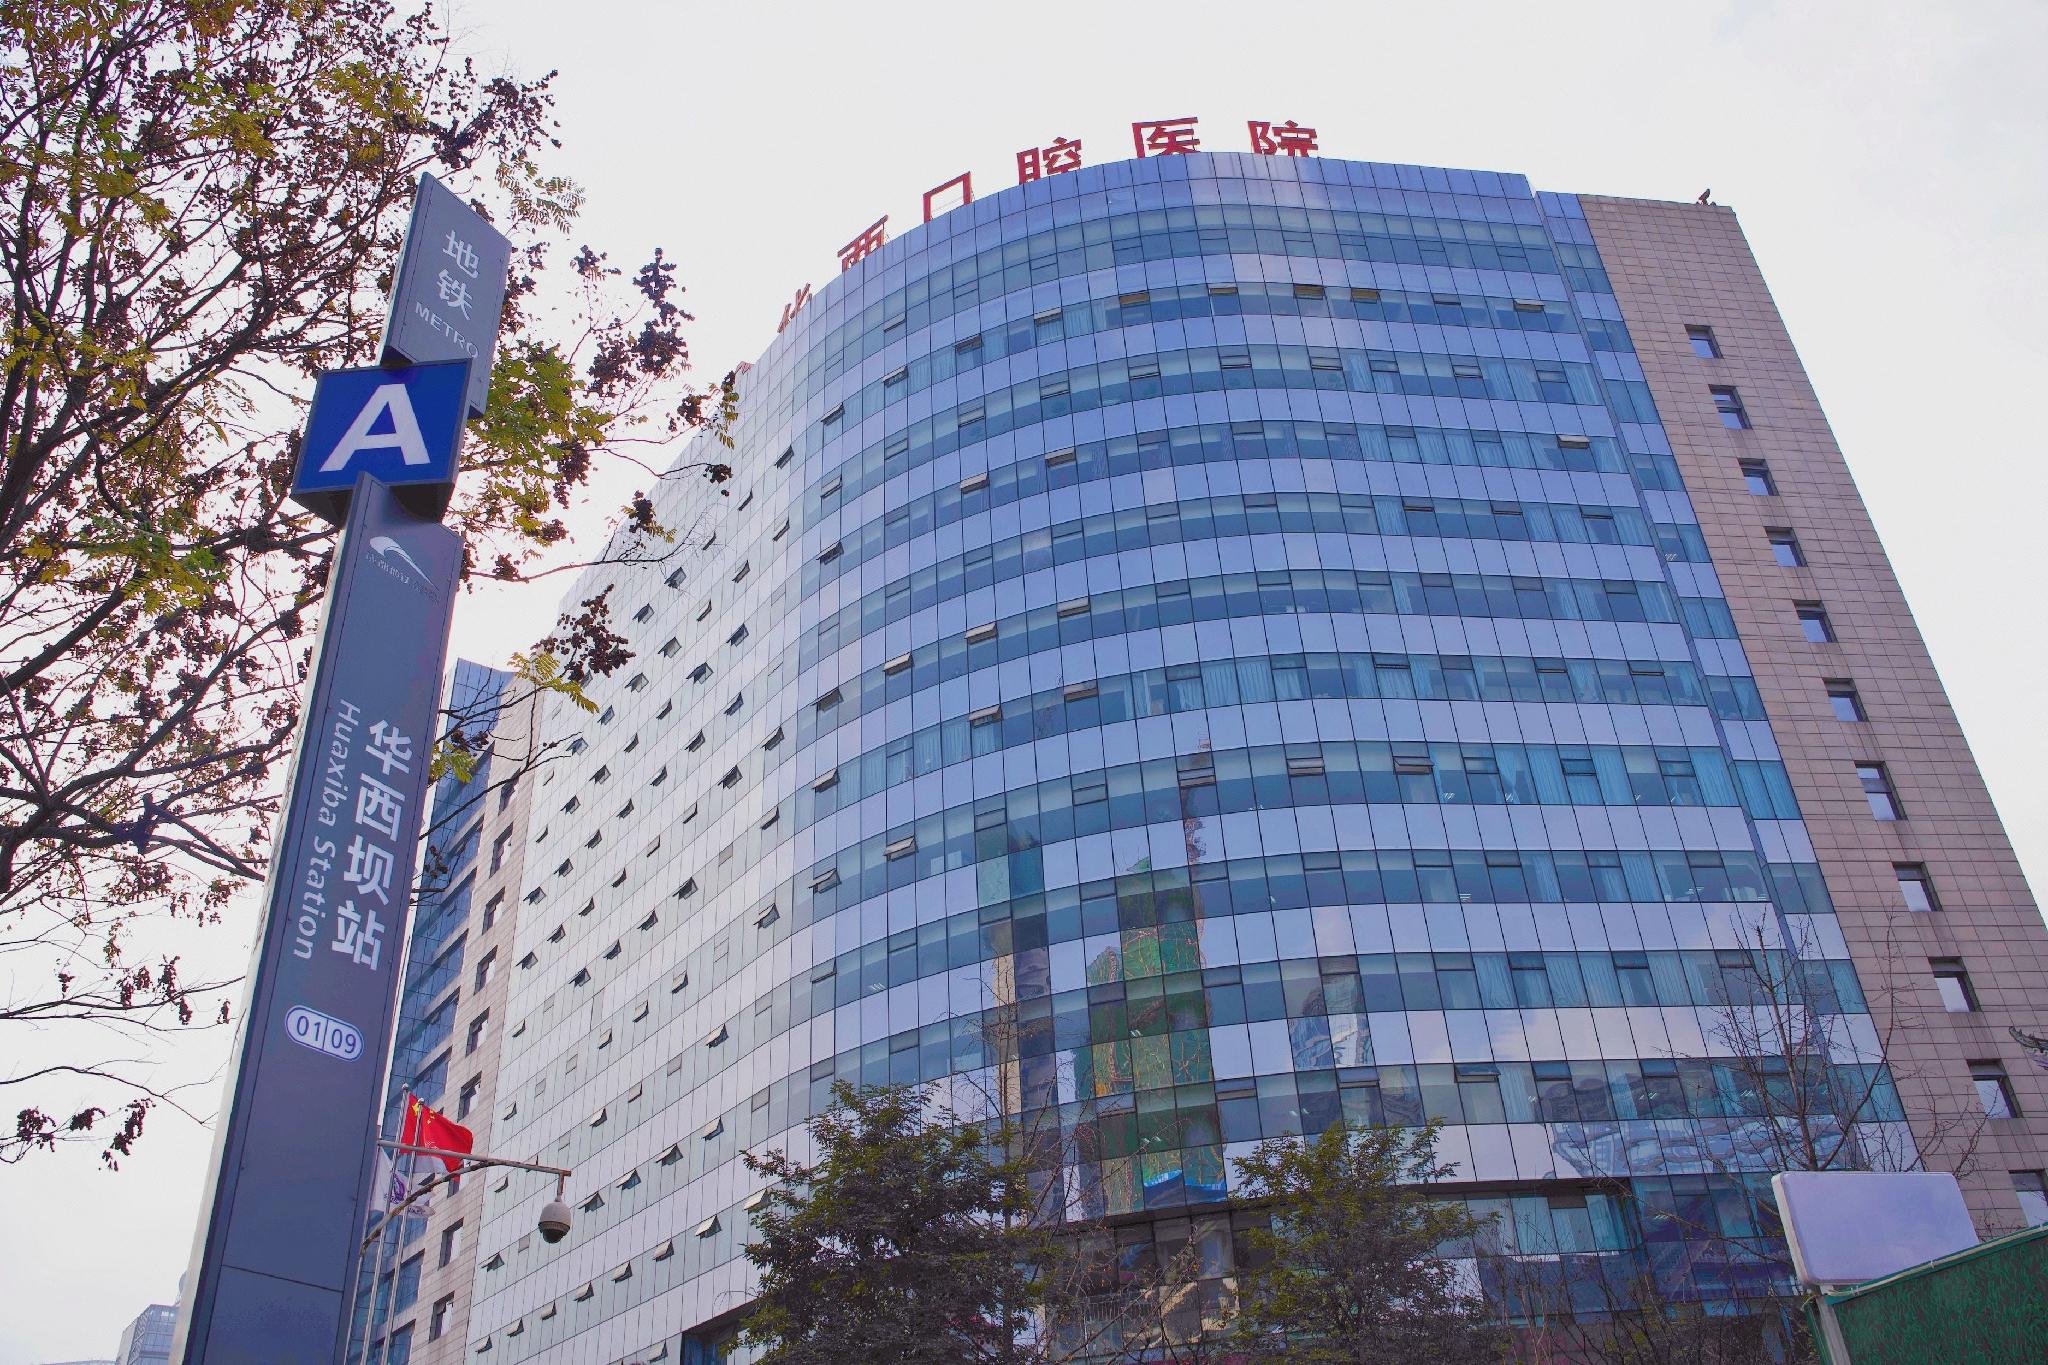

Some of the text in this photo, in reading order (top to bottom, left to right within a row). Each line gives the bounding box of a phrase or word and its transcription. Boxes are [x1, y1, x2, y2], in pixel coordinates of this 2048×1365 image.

[436, 229, 480, 321] 地铁
[415, 300, 479, 359] METRO
[319, 383, 431, 473] A
[293, 699, 361, 960] Huaxiba Station
[331, 719, 413, 972] 华西坝站
